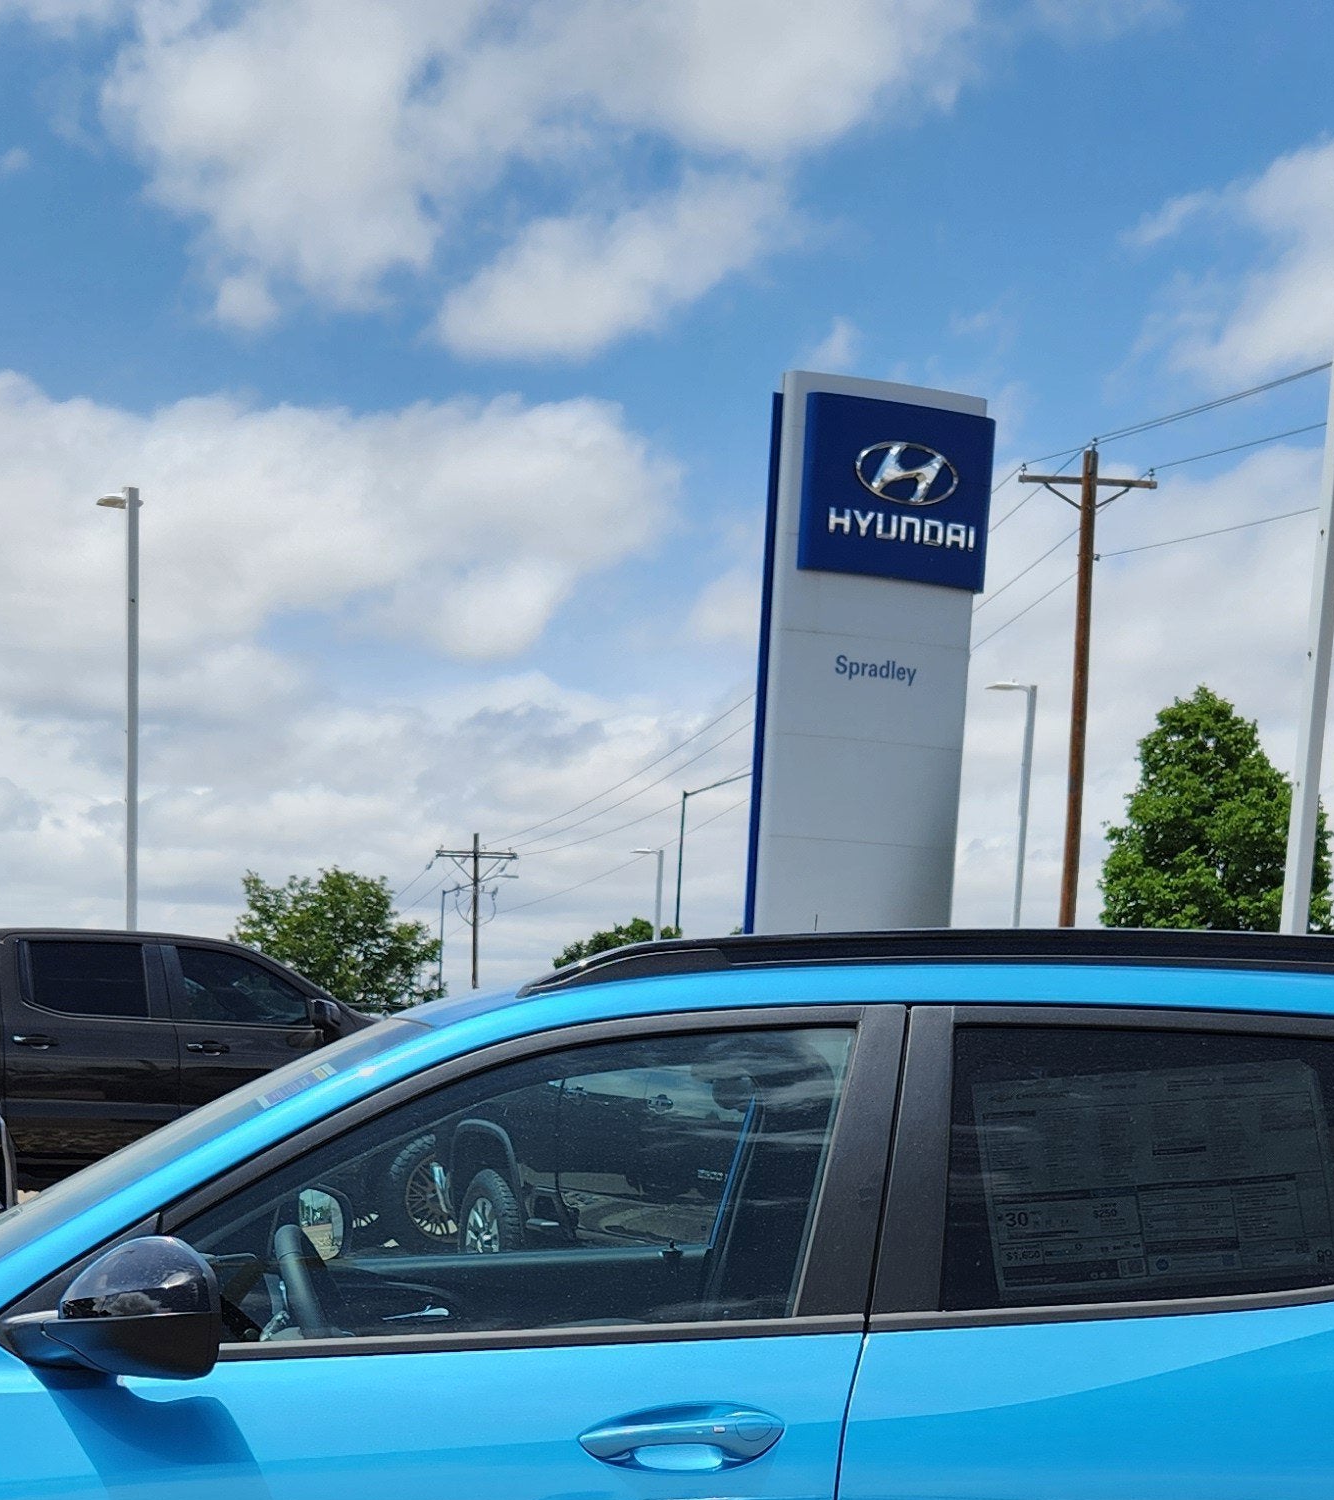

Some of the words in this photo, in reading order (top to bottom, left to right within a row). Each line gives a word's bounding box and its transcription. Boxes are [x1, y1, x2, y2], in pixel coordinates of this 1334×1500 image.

[828, 506, 975, 552] HYUNDAI
[835, 654, 917, 687] Spradley
[1005, 1211, 1028, 1228] 30
